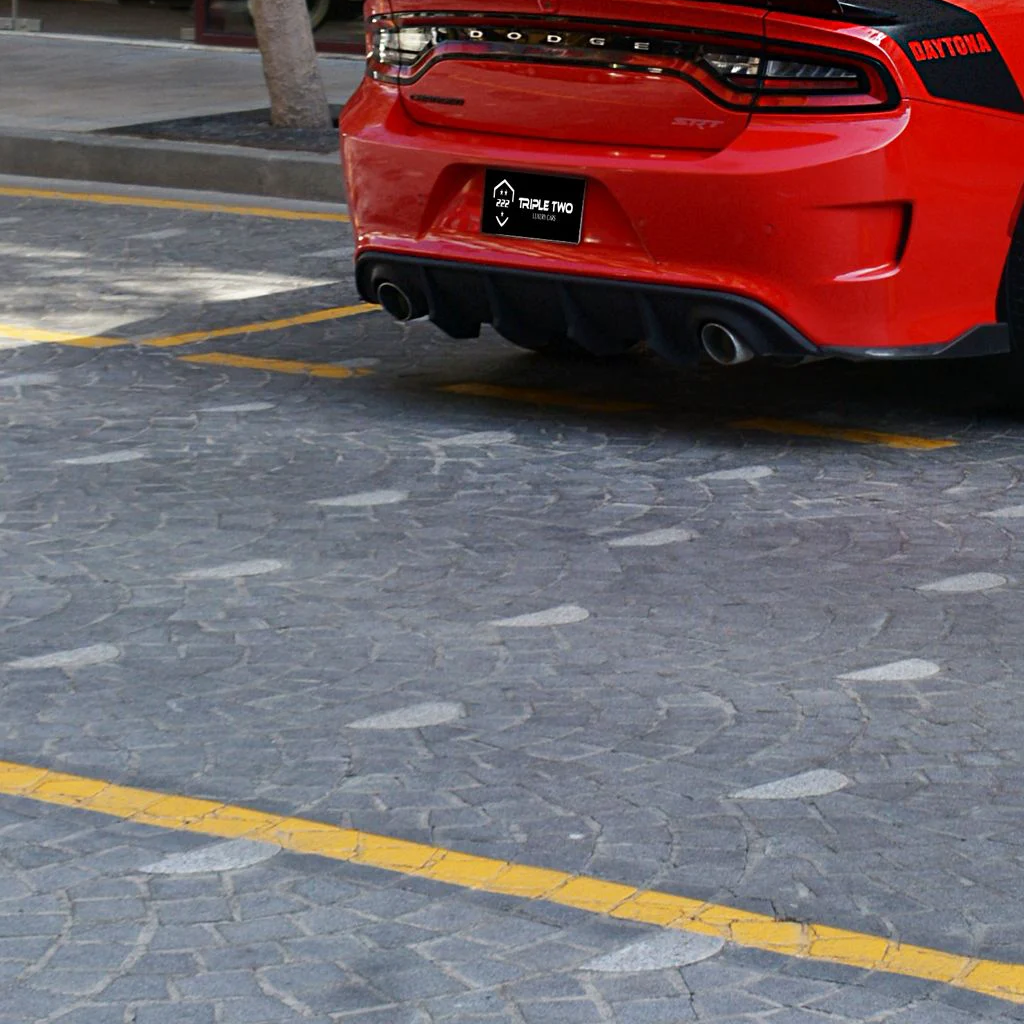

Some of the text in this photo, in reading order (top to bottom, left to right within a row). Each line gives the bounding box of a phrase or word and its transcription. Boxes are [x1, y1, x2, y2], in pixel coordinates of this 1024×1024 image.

[469, 29, 650, 51] DODGE
[908, 32, 992, 61] DAYTONA
[495, 198, 510, 208] 222
[518, 197, 574, 214] TRIPLE TWO
